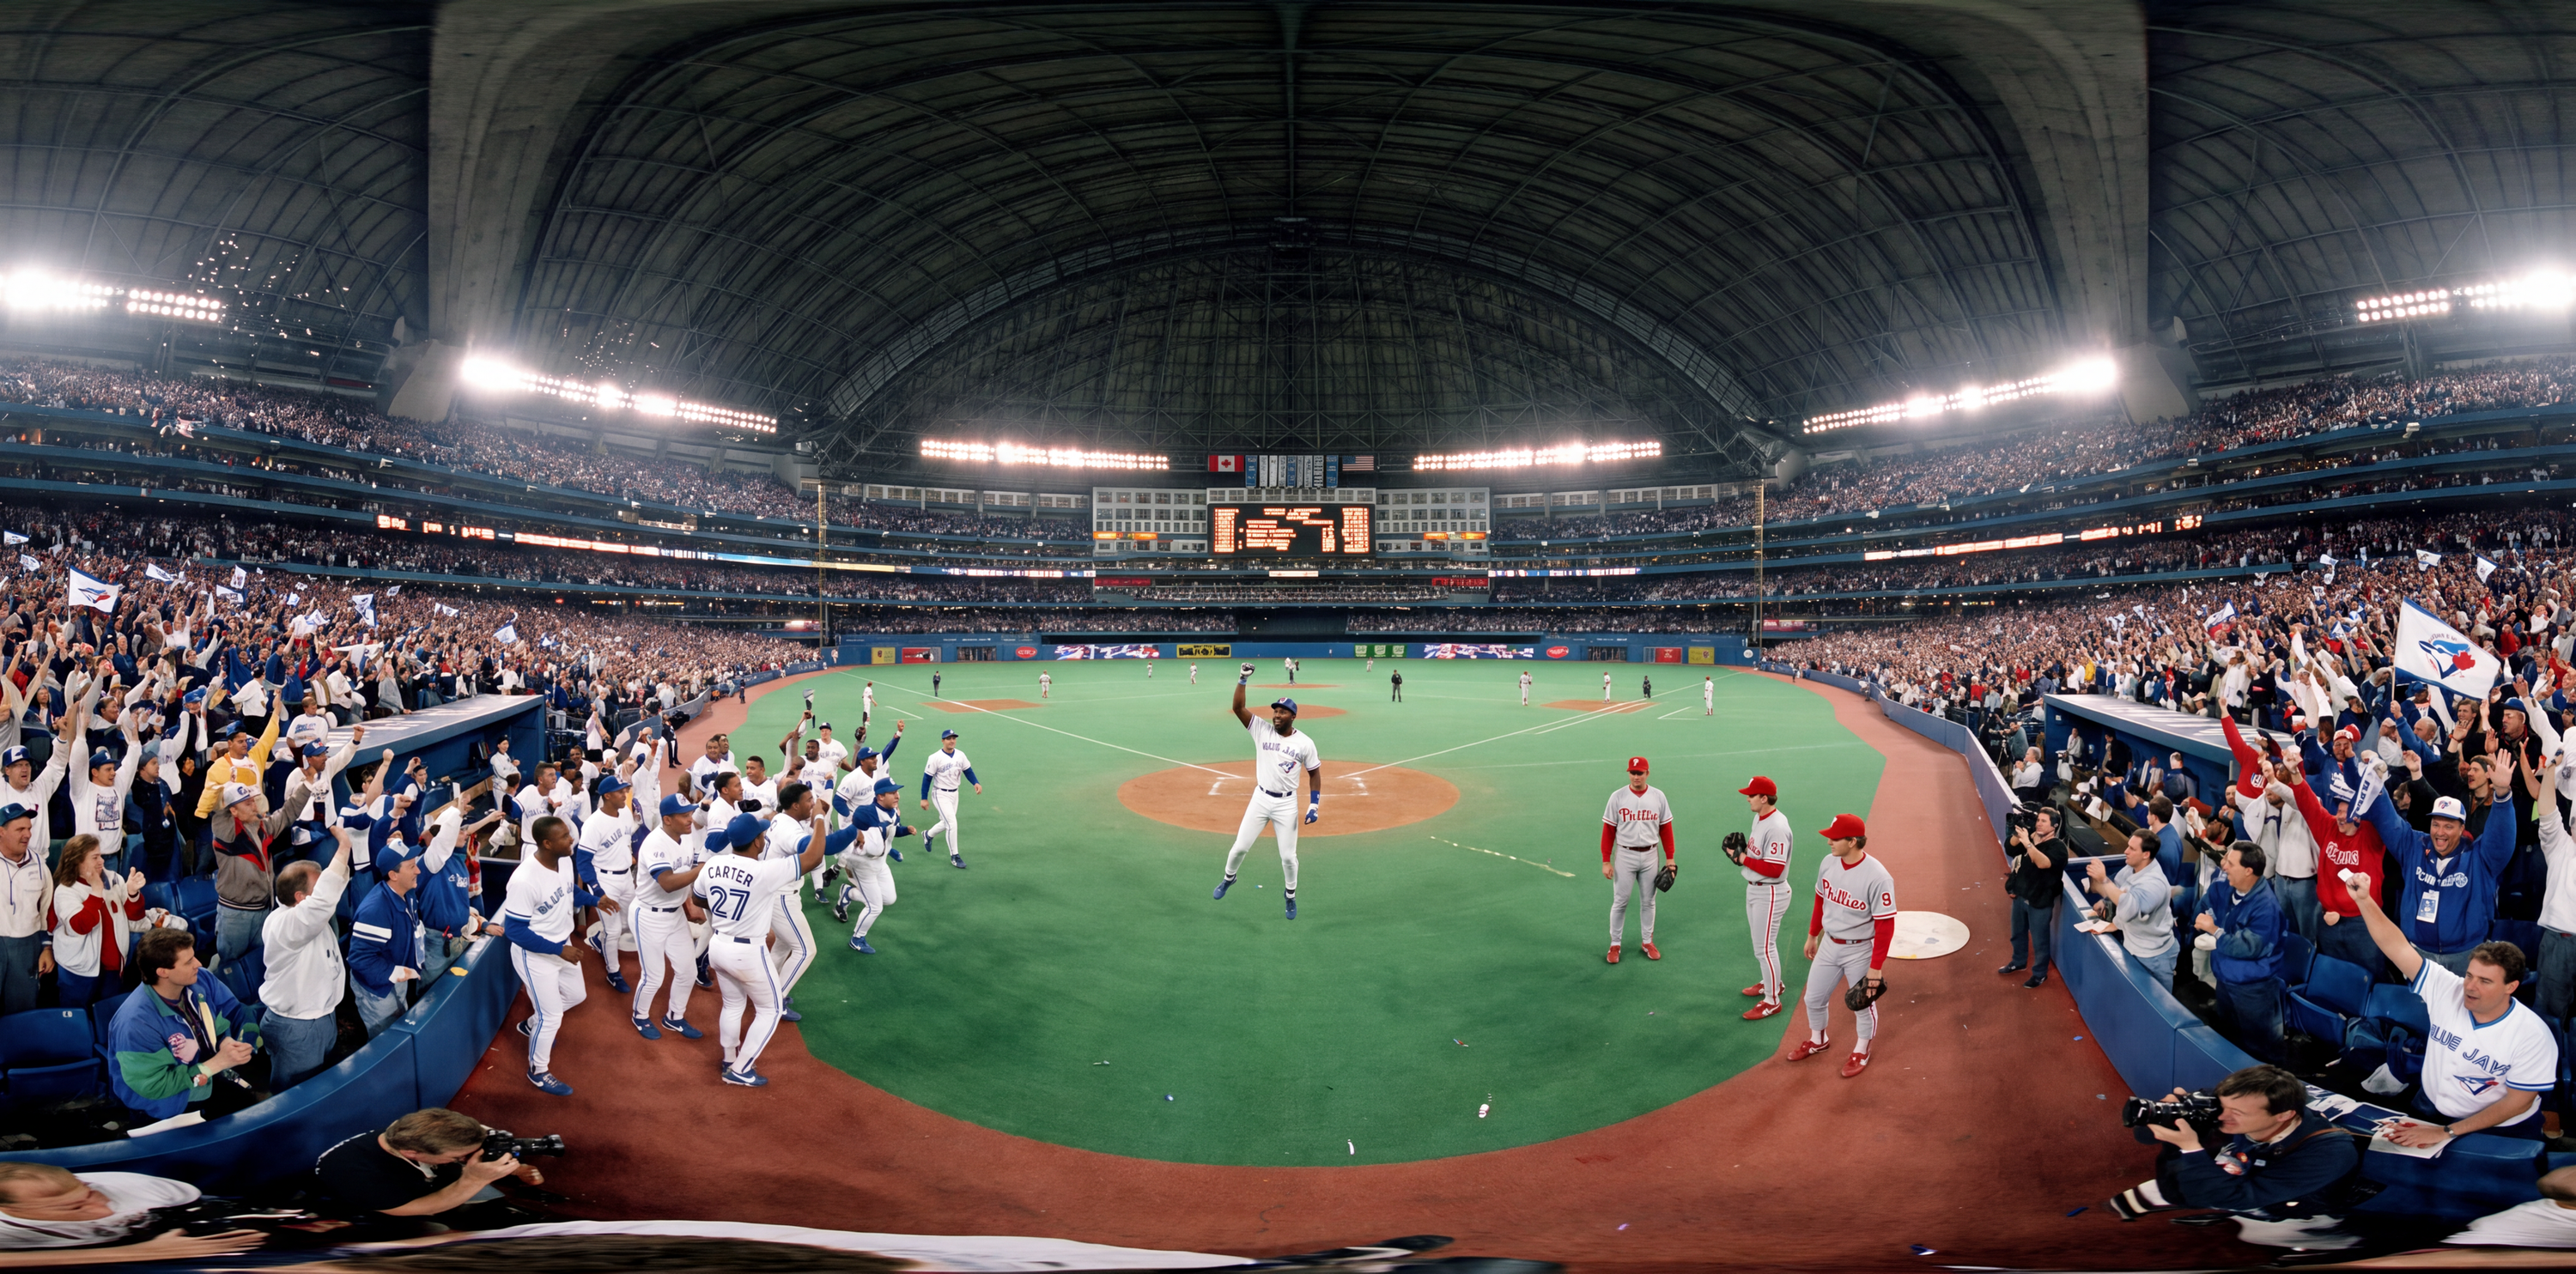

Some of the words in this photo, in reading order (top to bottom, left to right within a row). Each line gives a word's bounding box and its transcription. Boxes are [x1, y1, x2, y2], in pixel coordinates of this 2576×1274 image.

[1770, 841, 1784, 855] 31
[708, 865, 754, 888] CARTER
[709, 885, 750, 921] 27
[1822, 878, 1867, 911] Phillies
[1881, 892, 1892, 907] 9
